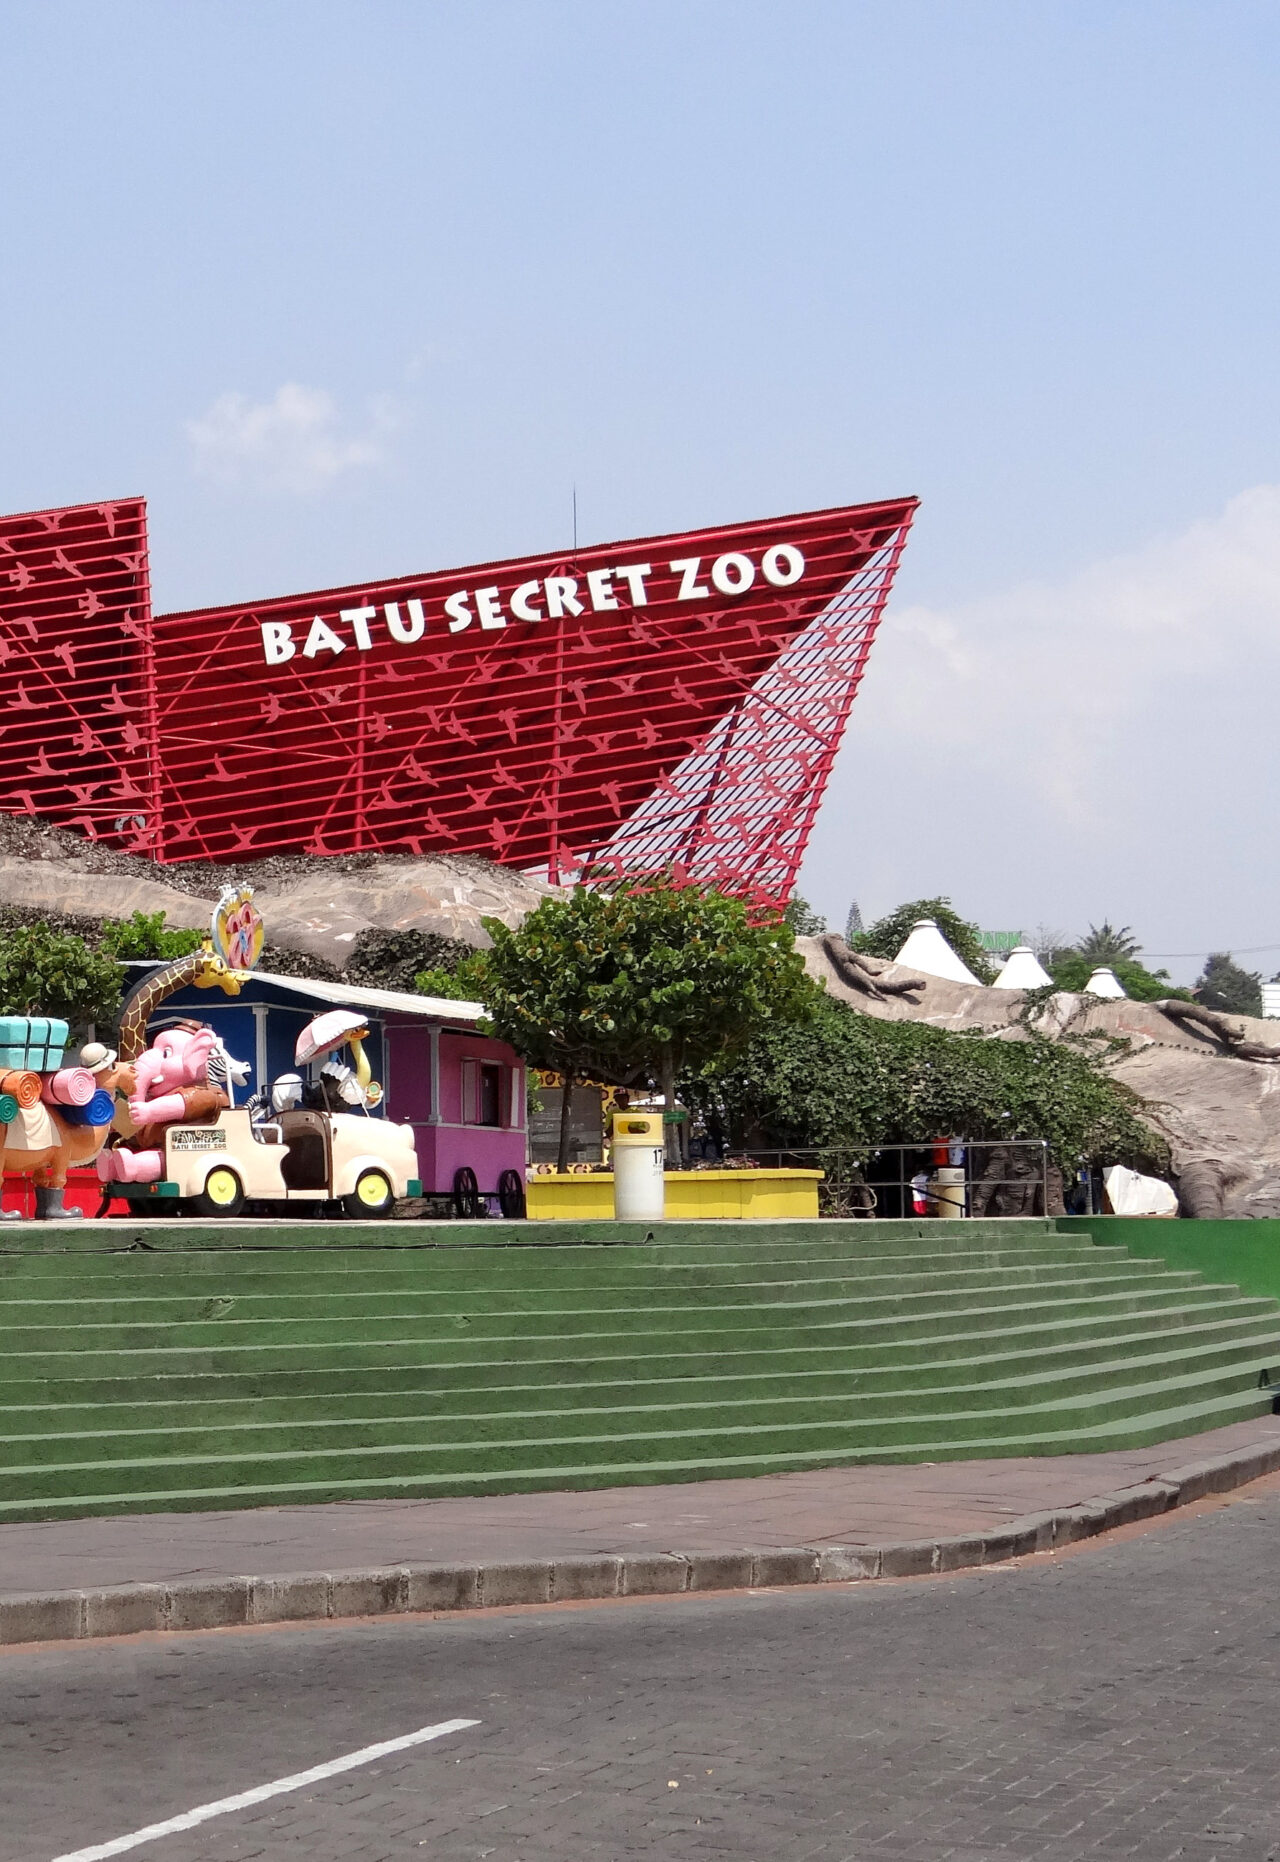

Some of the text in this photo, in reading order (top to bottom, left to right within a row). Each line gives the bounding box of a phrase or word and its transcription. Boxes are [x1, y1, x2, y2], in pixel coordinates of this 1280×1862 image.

[261, 544, 805, 665] BATU SECRET ZOO
[653, 1149, 663, 1164] 17
